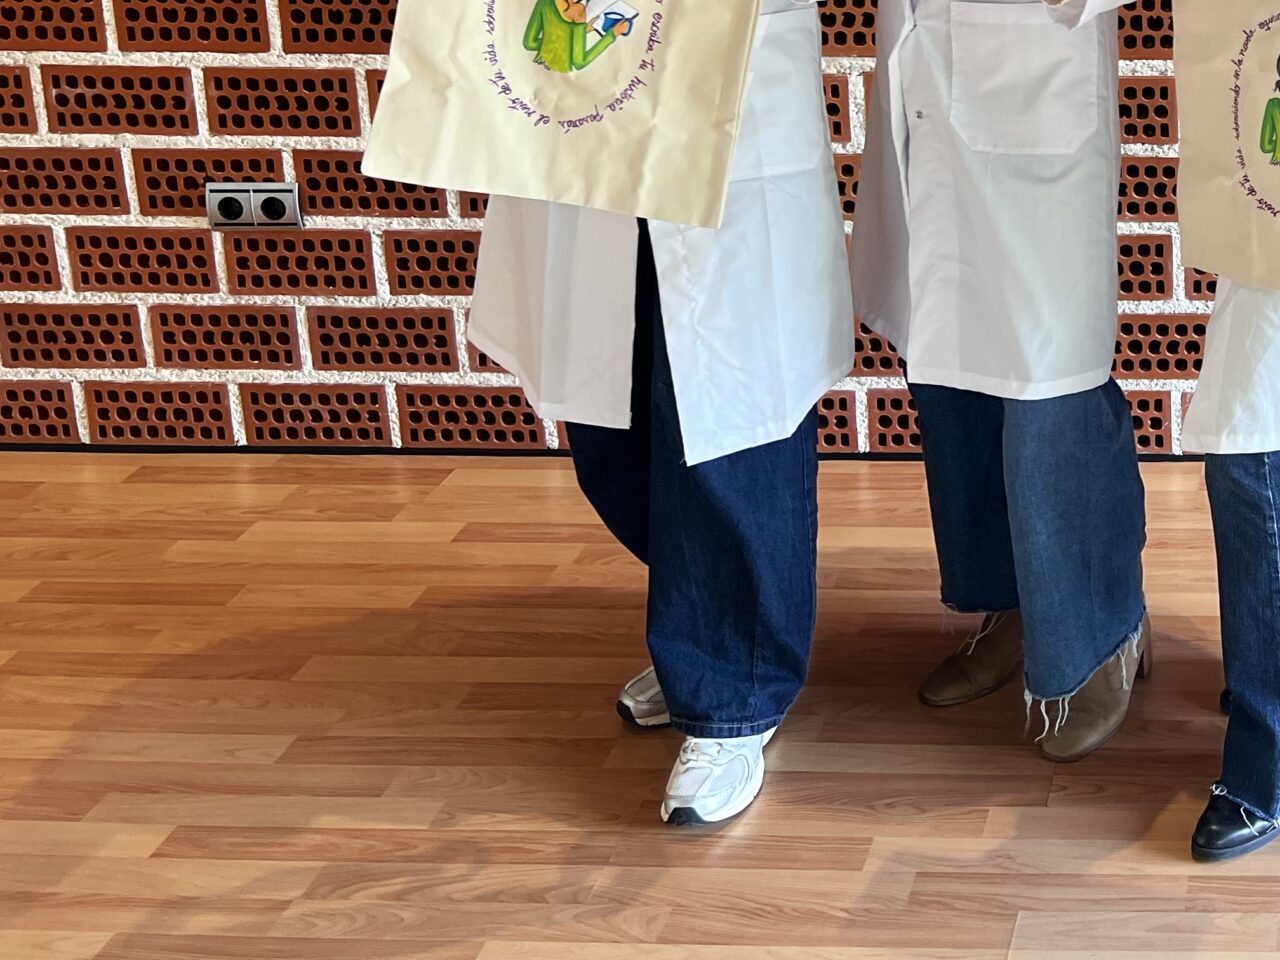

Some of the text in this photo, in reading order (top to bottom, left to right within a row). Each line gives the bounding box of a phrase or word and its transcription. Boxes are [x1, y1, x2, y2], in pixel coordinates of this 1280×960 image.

[646, 12, 662, 54] escriba
[484, 40, 499, 66] vida
[497, 84, 512, 96] de
[534, 113, 550, 127] el
[1232, 146, 1246, 169] vida
[1246, 184, 1257, 197] de
